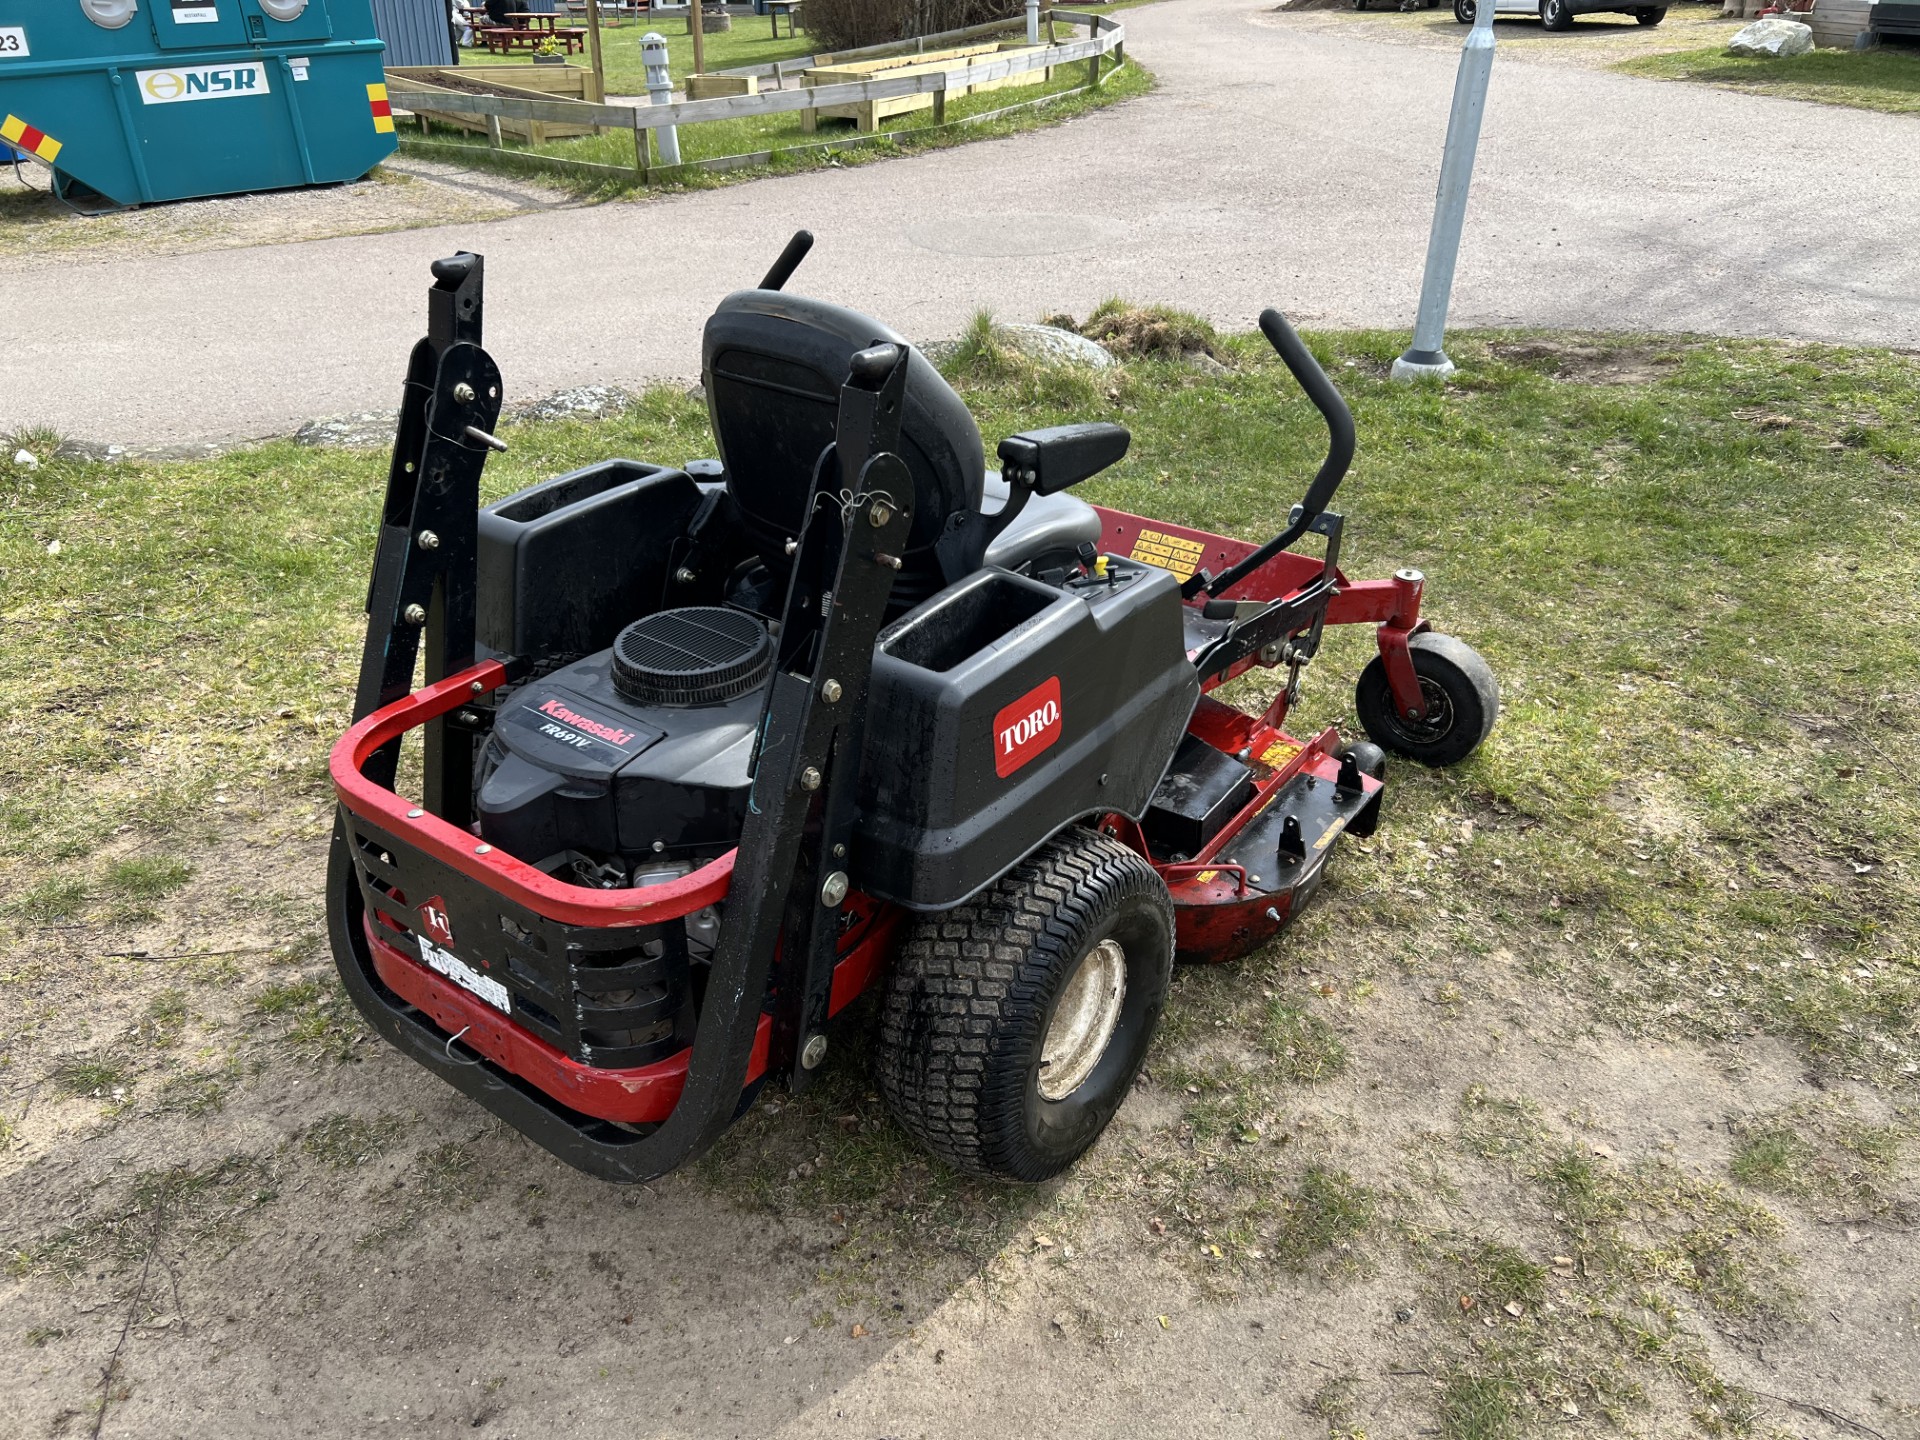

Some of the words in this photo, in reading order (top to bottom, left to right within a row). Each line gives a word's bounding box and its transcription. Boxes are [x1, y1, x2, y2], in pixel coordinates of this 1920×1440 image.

[184, 68, 257, 94] NSR
[538, 699, 636, 746] Kawasaki
[539, 723, 593, 747] FR691V
[999, 700, 1058, 756] TORO
